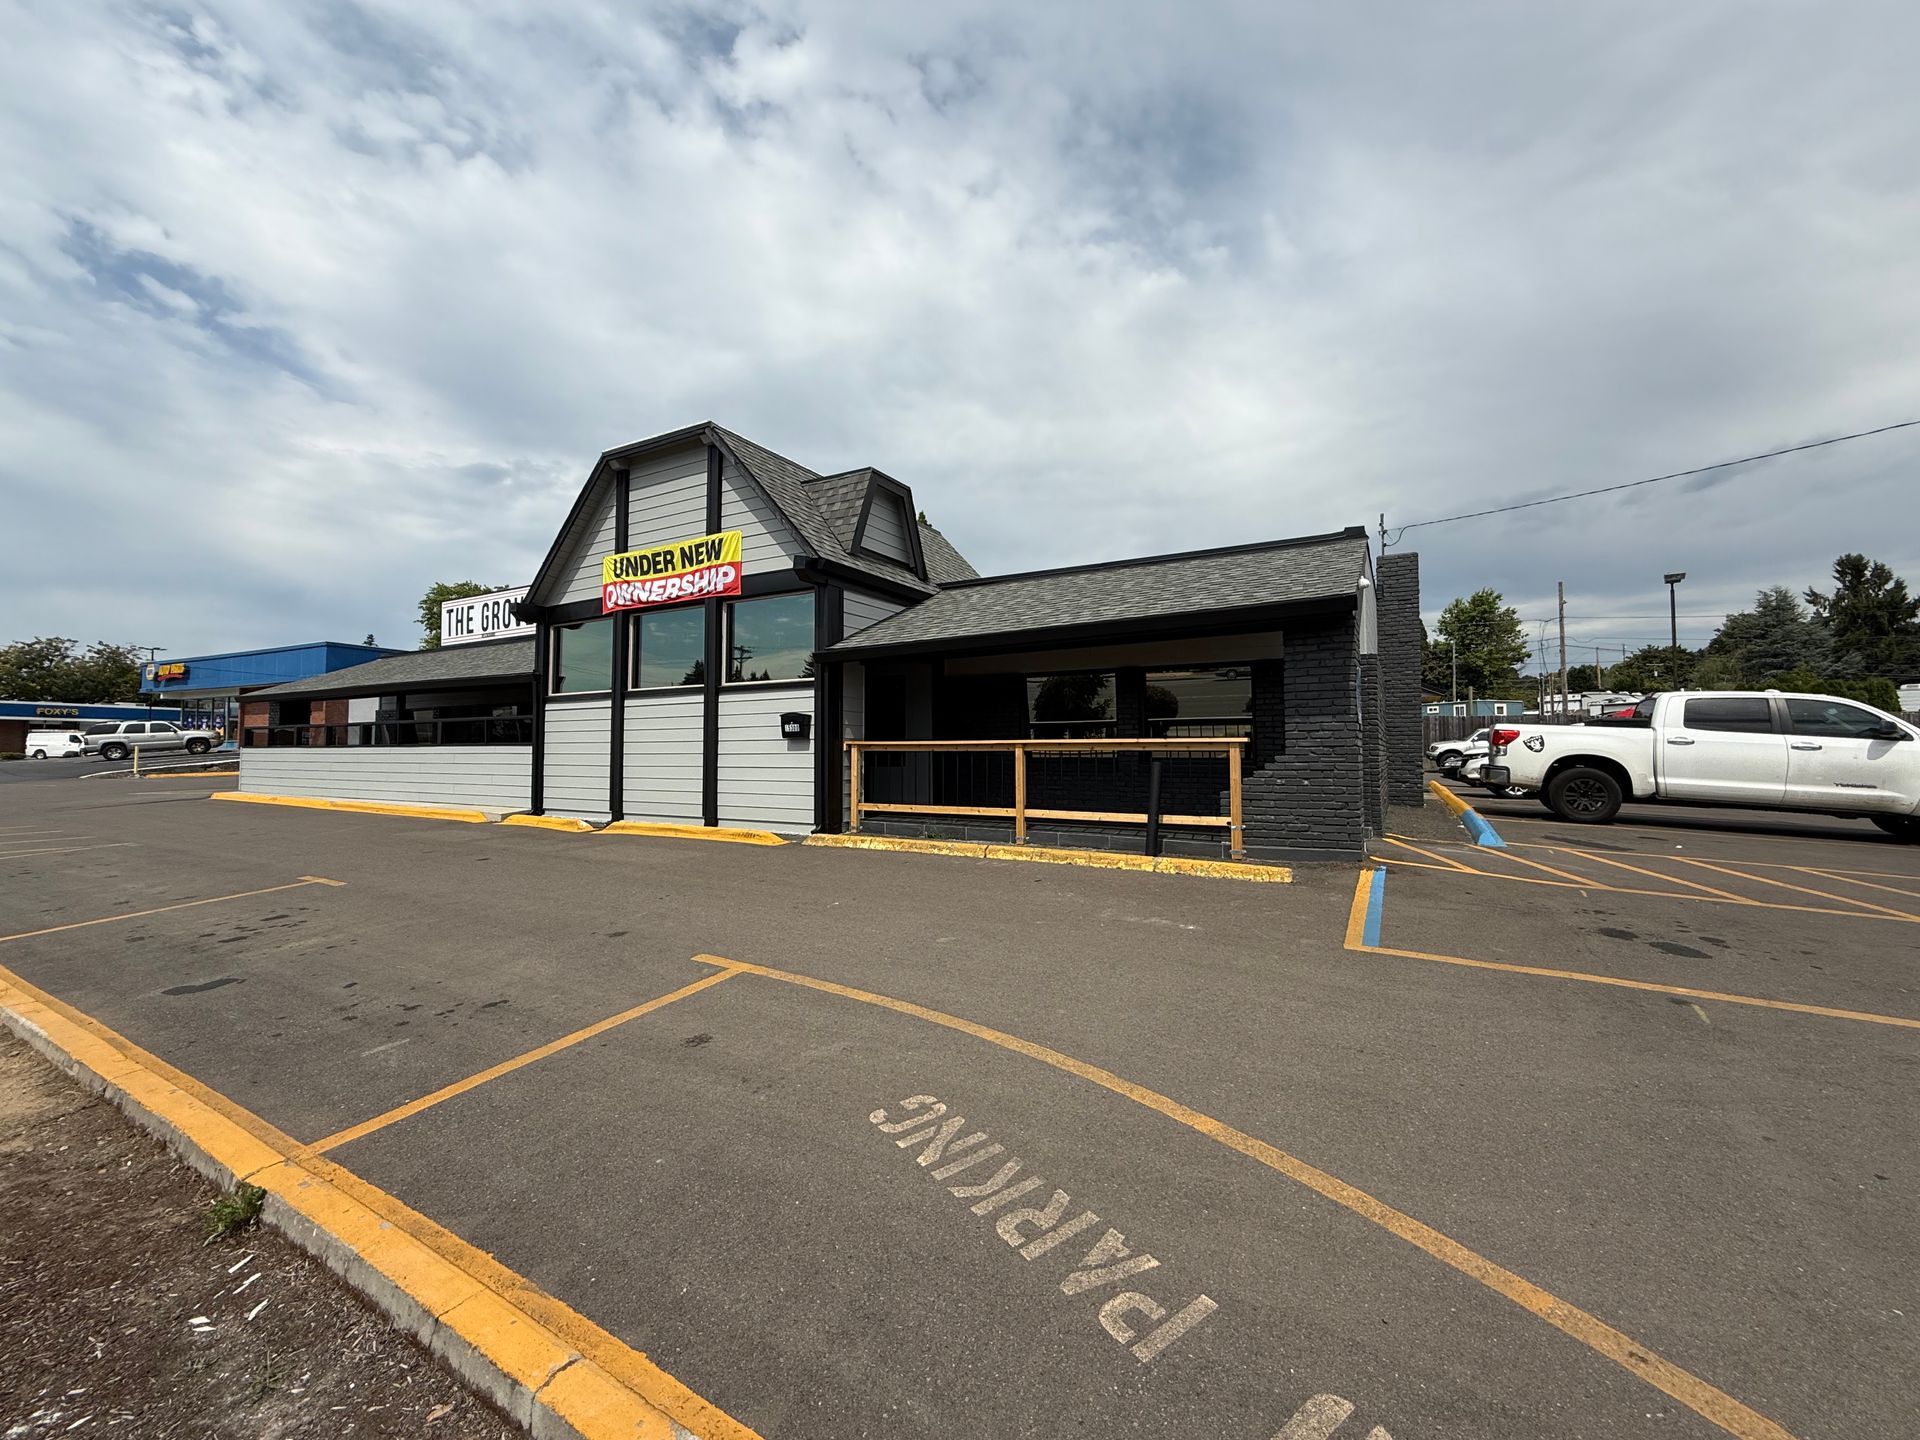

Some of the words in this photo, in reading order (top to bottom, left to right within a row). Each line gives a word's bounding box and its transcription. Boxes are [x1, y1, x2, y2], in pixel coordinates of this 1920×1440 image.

[614, 550, 676, 578] UNDER
[680, 538, 723, 569] NEW
[606, 565, 736, 609] OWNERSHIP
[446, 605, 474, 637] THE
[481, 596, 535, 632] GRO
[36, 707, 79, 716] FOXY'S
[869, 1094, 1219, 1363] PARKING
